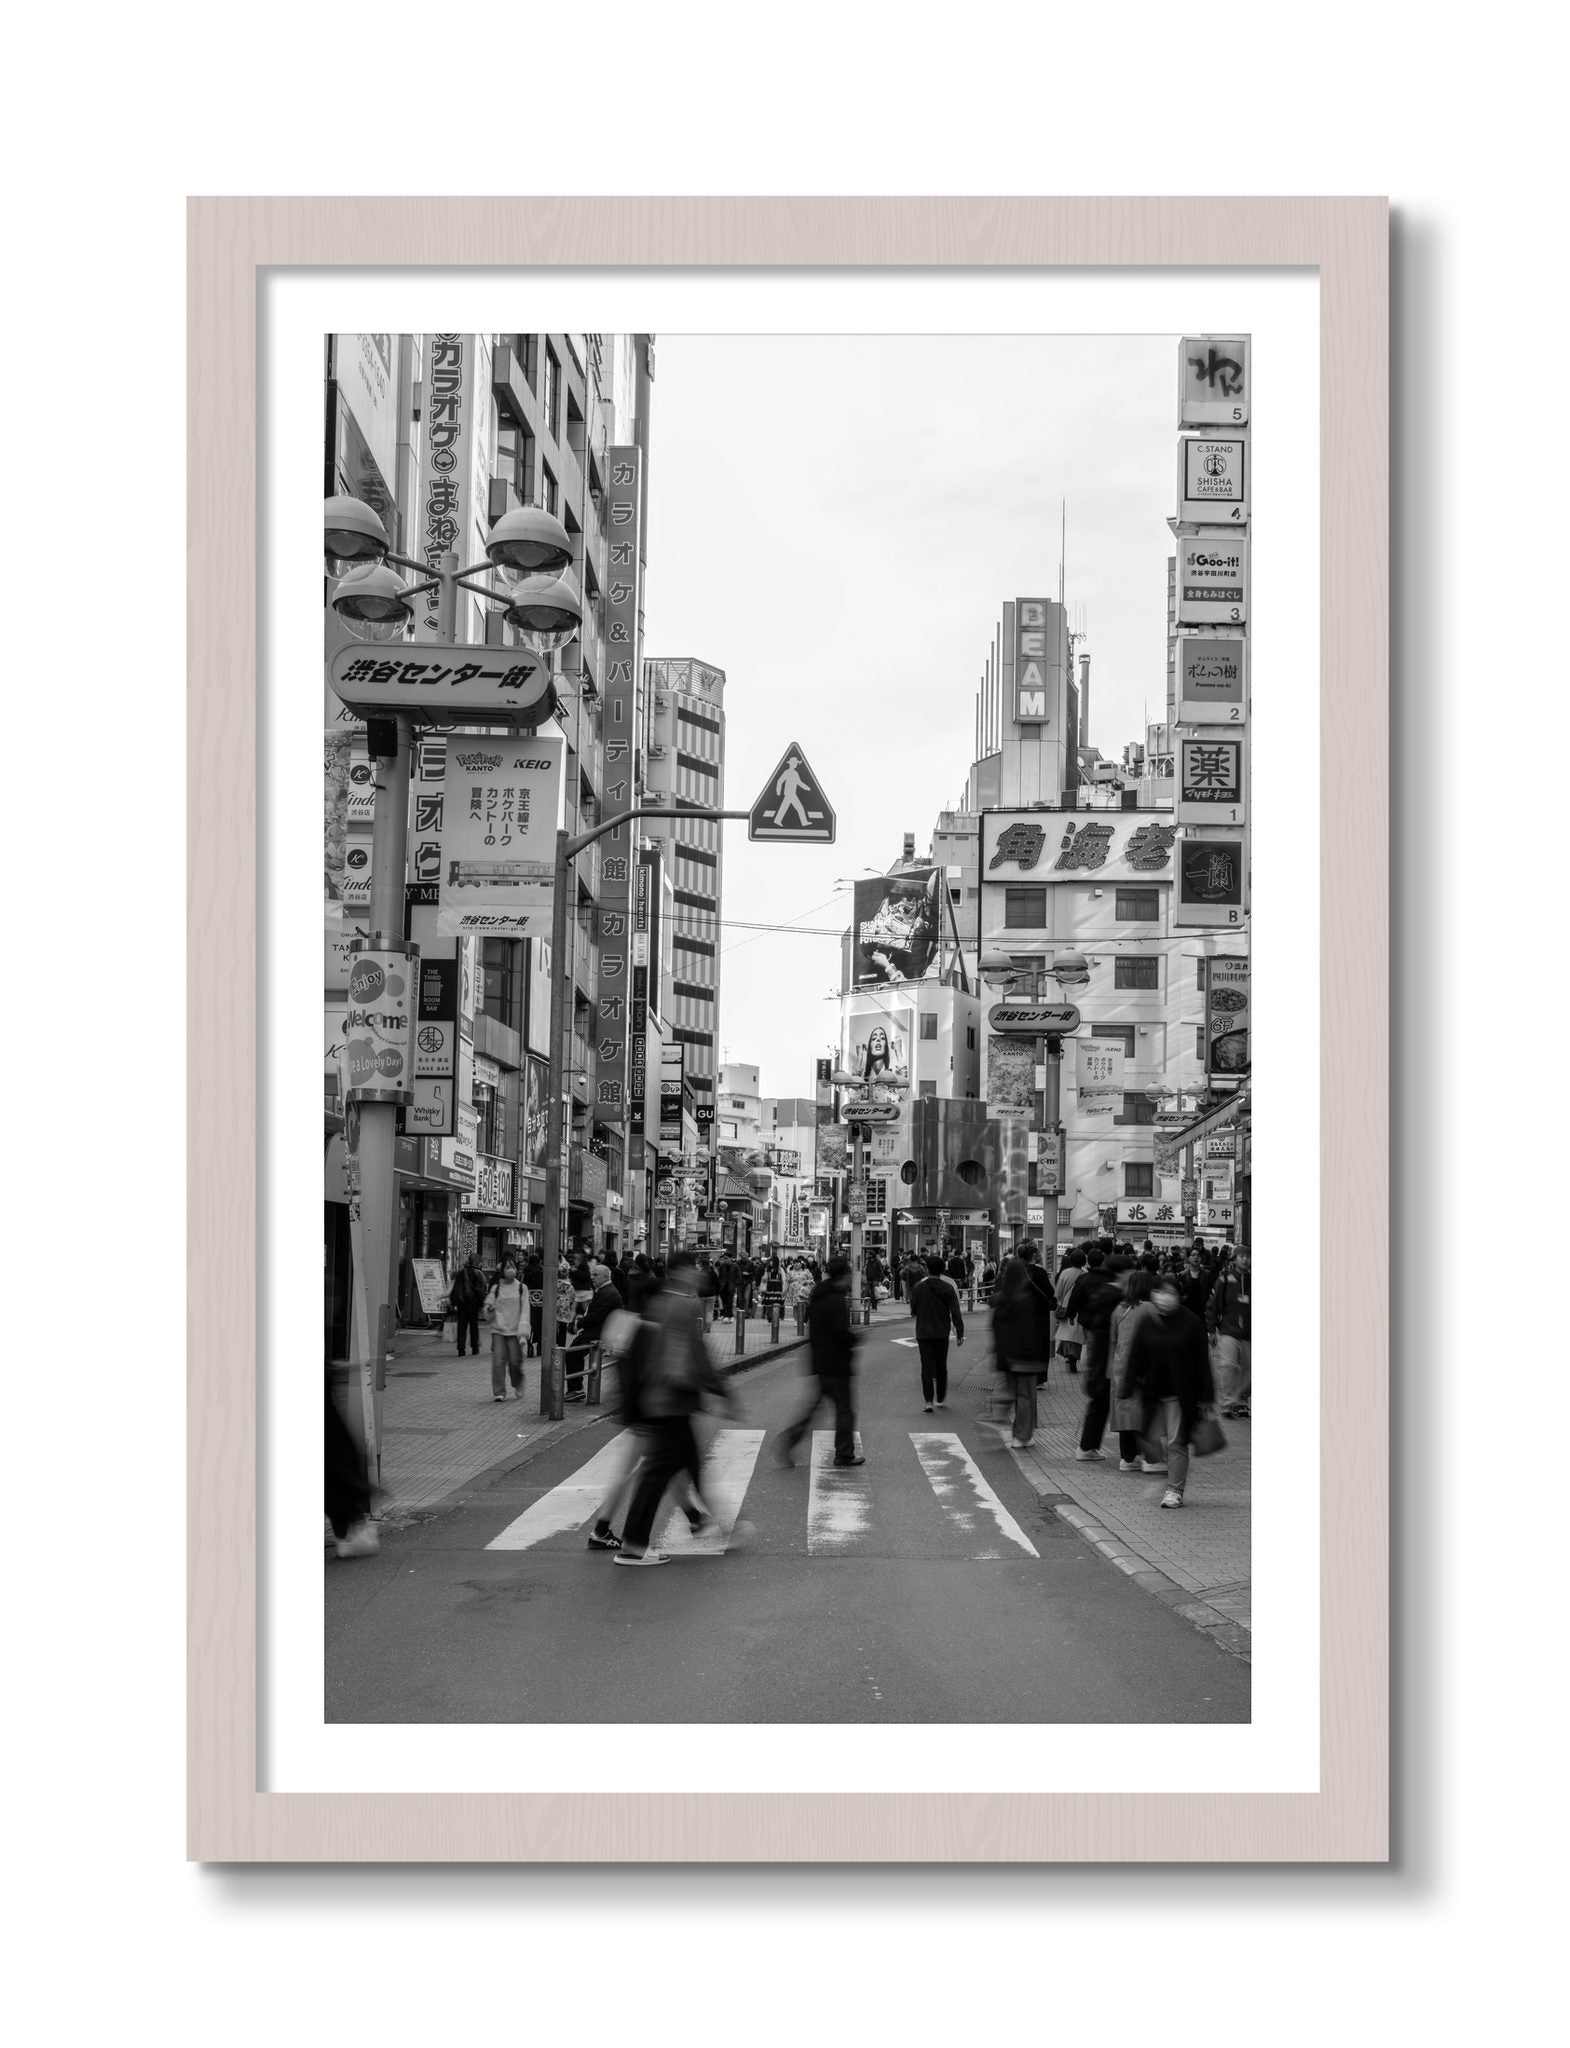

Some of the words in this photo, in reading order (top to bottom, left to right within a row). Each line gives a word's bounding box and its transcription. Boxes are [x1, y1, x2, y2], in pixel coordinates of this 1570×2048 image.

[430, 341, 462, 450] カラオケ
[1232, 407, 1242, 420] 5
[1197, 445, 1234, 454] C.STAND
[1197, 477, 1233, 486] SHISHA
[1197, 485, 1233, 493] CAFE&BAR
[1196, 554, 1239, 567] Goo-it!
[1191, 569, 1237, 577] 渋谷宇田川町店
[1186, 590, 1240, 599] 全身もみほぐし
[1230, 607, 1240, 620] 3
[1019, 601, 1047, 716] BEAM
[341, 659, 537, 689] 渋谷センター街
[1230, 708, 1239, 720] 2
[513, 759, 552, 770] KEIO
[1190, 746, 1230, 786] 薬
[416, 726, 447, 882] ラオケ
[469, 786, 482, 821] 冒険へ
[484, 787, 499, 846] カントーの
[517, 788, 531, 835] 京王線で
[1229, 808, 1237, 821] 1
[988, 822, 1180, 871] 角海老
[1185, 852, 1234, 892] 一蘭
[459, 915, 530, 926] 渋谷センター街
[1228, 910, 1239, 922] B
[351, 970, 384, 997] Enjoy
[598, 912, 627, 1105] カラオケ館
[347, 1009, 409, 1029] Welcome
[994, 1011, 1075, 1022] 渋谷センター街
[1210, 1017, 1235, 1034] 6F
[361, 1055, 385, 1070] Lovely
[414, 1107, 441, 1116] Whisky
[697, 1109, 714, 1119] GU
[843, 1107, 893, 1115] 渋谷センター街
[1127, 1203, 1175, 1221] 兆楽
